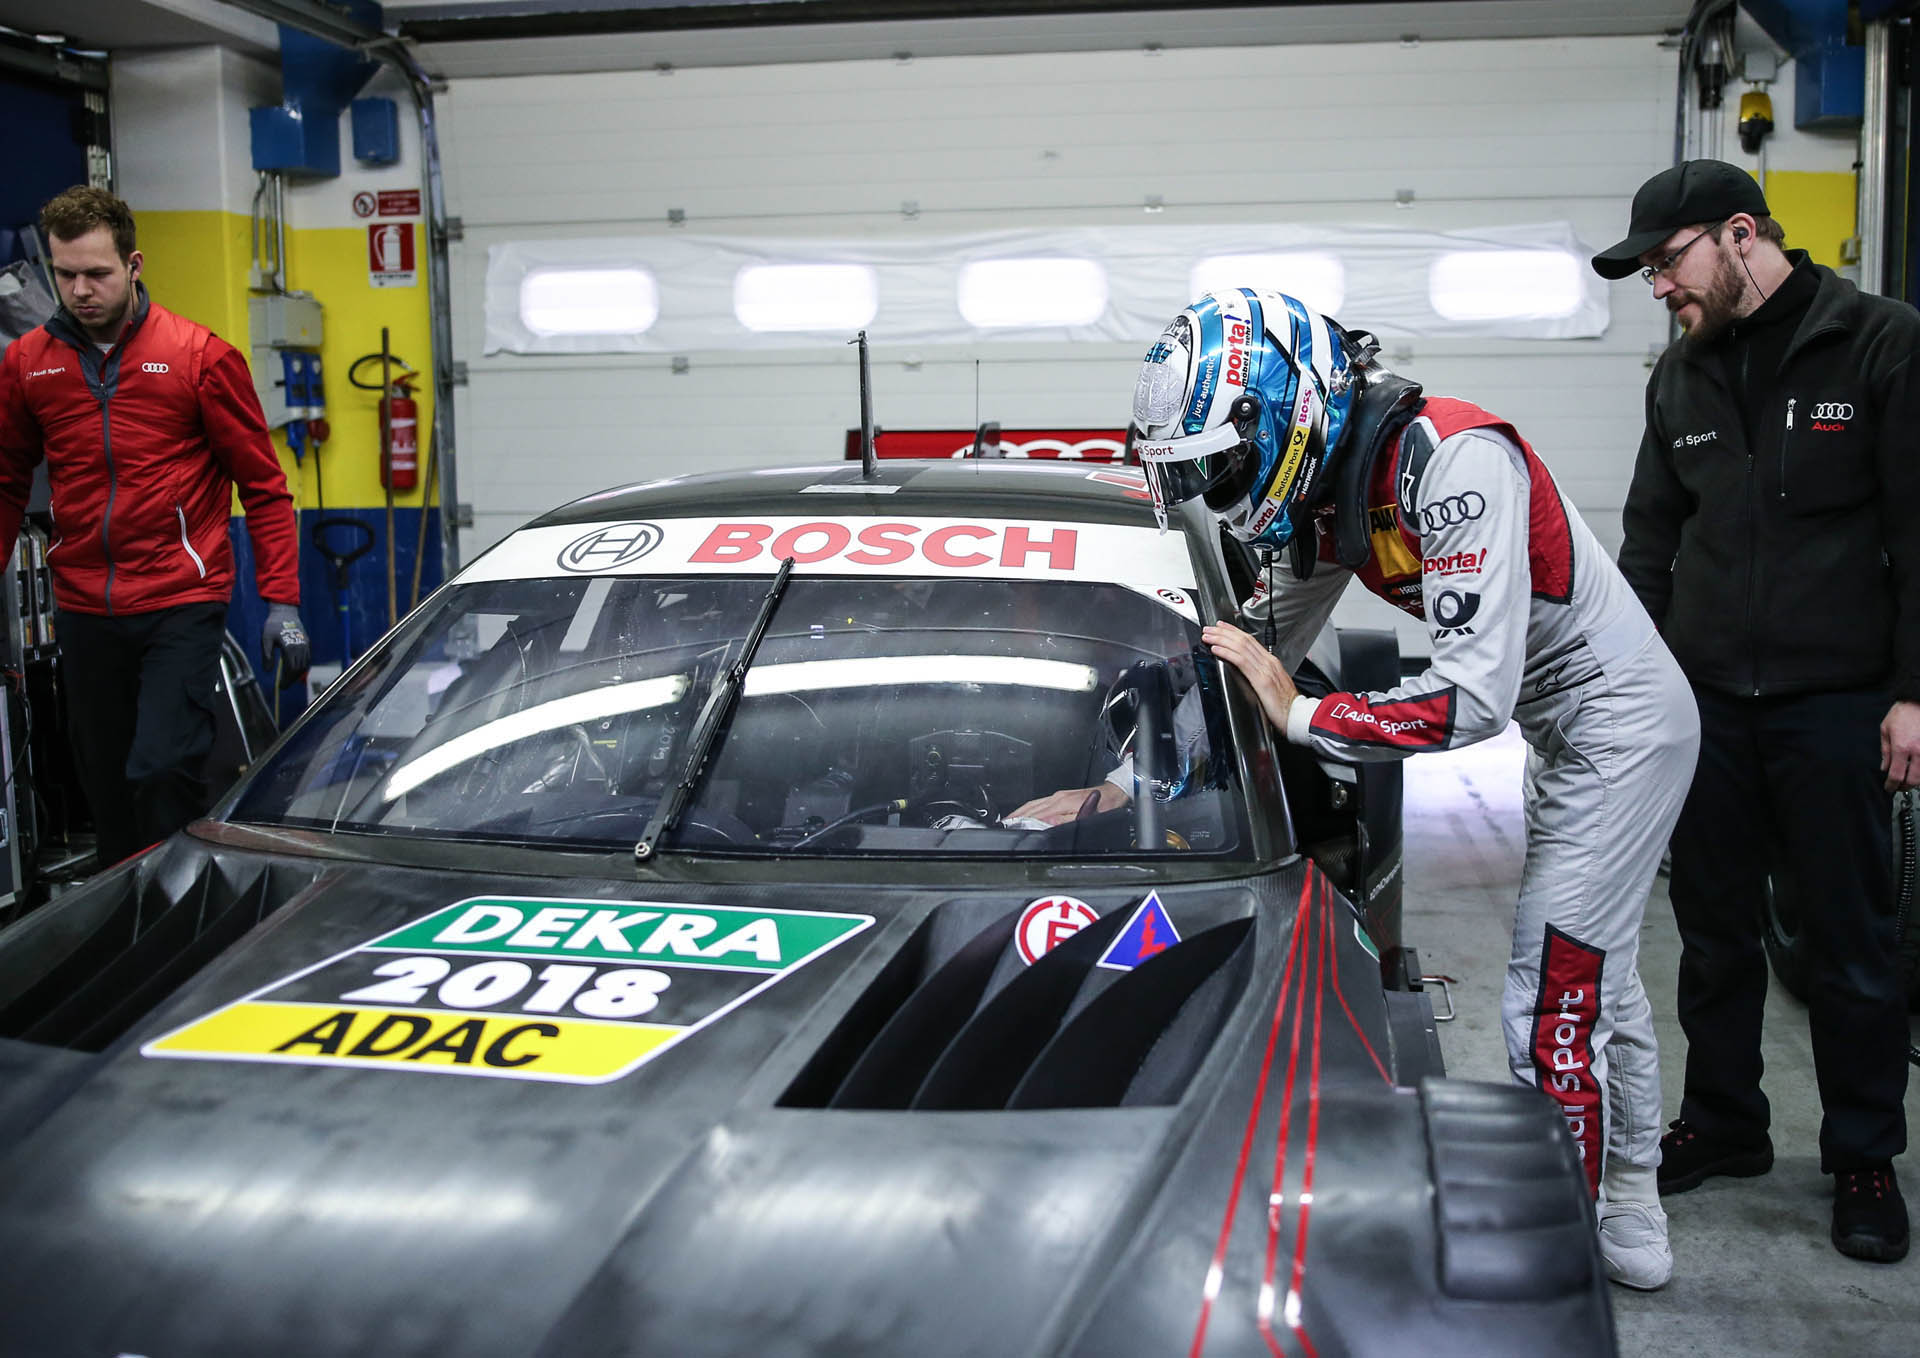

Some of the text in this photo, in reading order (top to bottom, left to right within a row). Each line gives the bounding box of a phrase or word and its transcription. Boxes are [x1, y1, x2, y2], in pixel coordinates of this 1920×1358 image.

[1223, 314, 1251, 387] porta!
[1200, 357, 1217, 399] authentic
[1298, 389, 1312, 423] BOSS
[1812, 422, 1845, 431] Audi
[1143, 445, 1174, 458] Sport
[1673, 430, 1717, 449] di Sport
[1274, 448, 1300, 498] Deutsche Post
[1252, 499, 1278, 534] porta!
[687, 522, 1078, 570] BOSCH
[1423, 547, 1488, 575] porta!
[1380, 719, 1428, 736] Sport
[432, 904, 782, 962] DEKRA
[339, 956, 672, 1018] 2018
[273, 1011, 560, 1068] ADAC
[1551, 989, 1584, 1092] Sport
